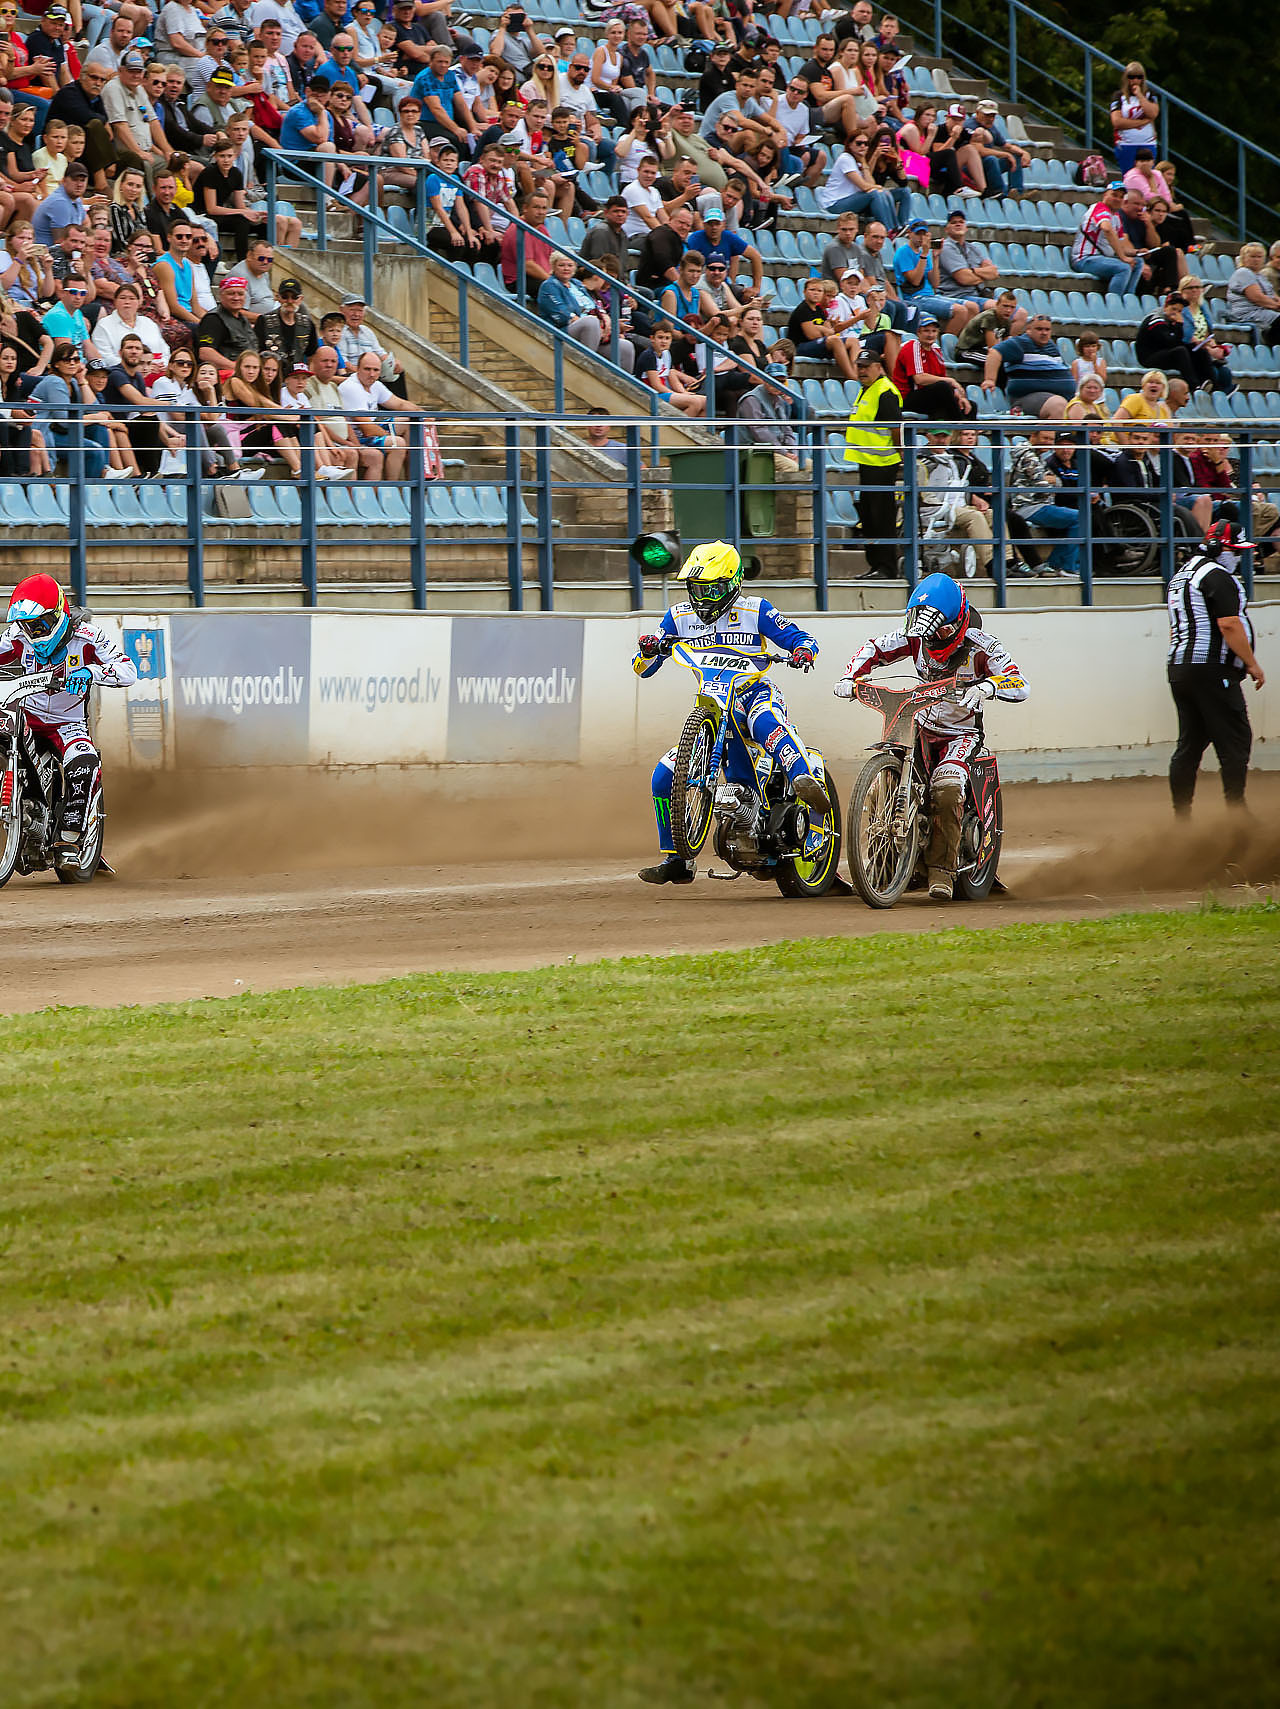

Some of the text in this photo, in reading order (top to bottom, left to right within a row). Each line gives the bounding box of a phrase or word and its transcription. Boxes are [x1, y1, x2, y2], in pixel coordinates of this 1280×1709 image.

[180, 666, 304, 714] www.gorod.lv
[320, 667, 441, 713] www.gorod.lv
[456, 667, 576, 713] www.gorod.lv
